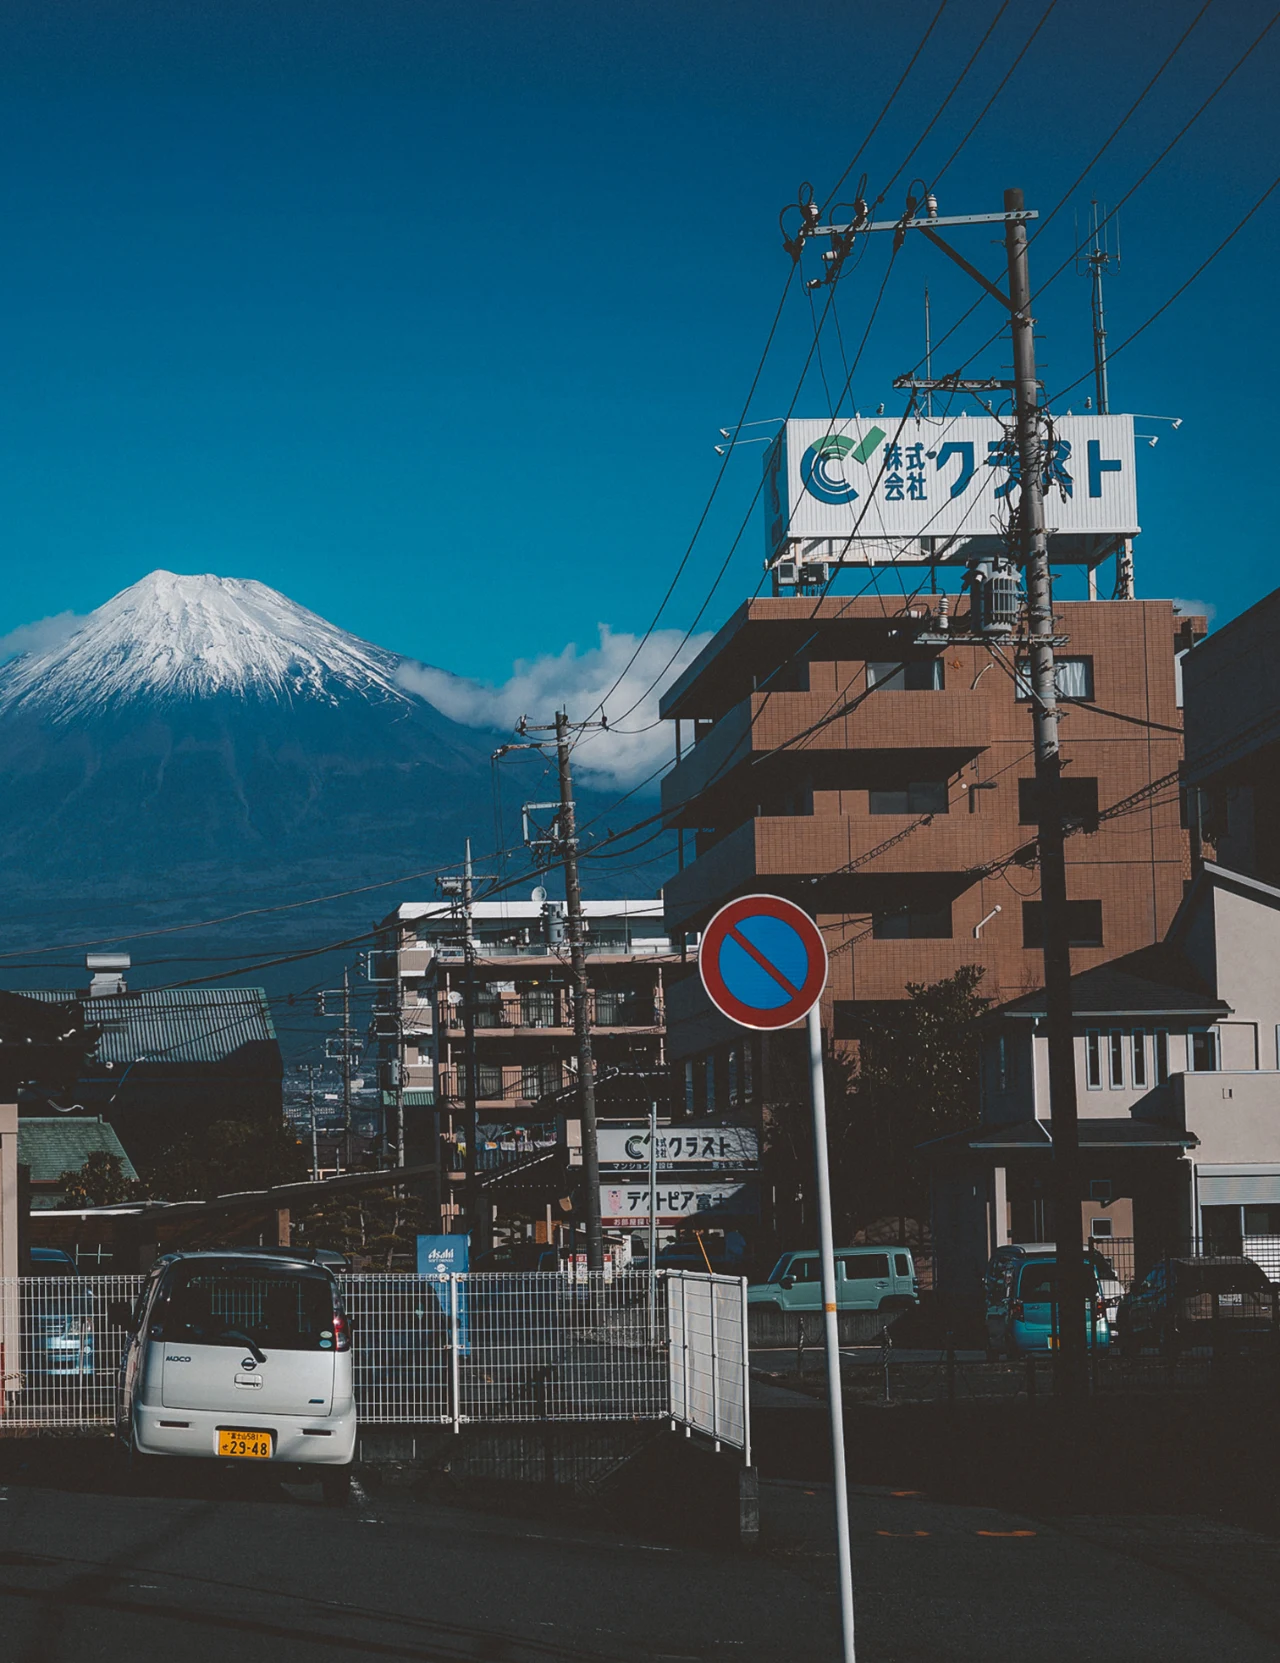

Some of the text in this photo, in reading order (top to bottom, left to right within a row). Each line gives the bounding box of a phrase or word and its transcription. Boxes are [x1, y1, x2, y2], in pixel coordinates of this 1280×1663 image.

[883, 442, 926, 471] 株式
[936, 439, 1122, 499] クラスト
[883, 472, 927, 500] 会社
[669, 1136, 731, 1158] クラスト
[613, 1162, 673, 1170] マンション設は
[428, 1248, 454, 1259] Asahi
[230, 1440, 267, 1456] 29-48
